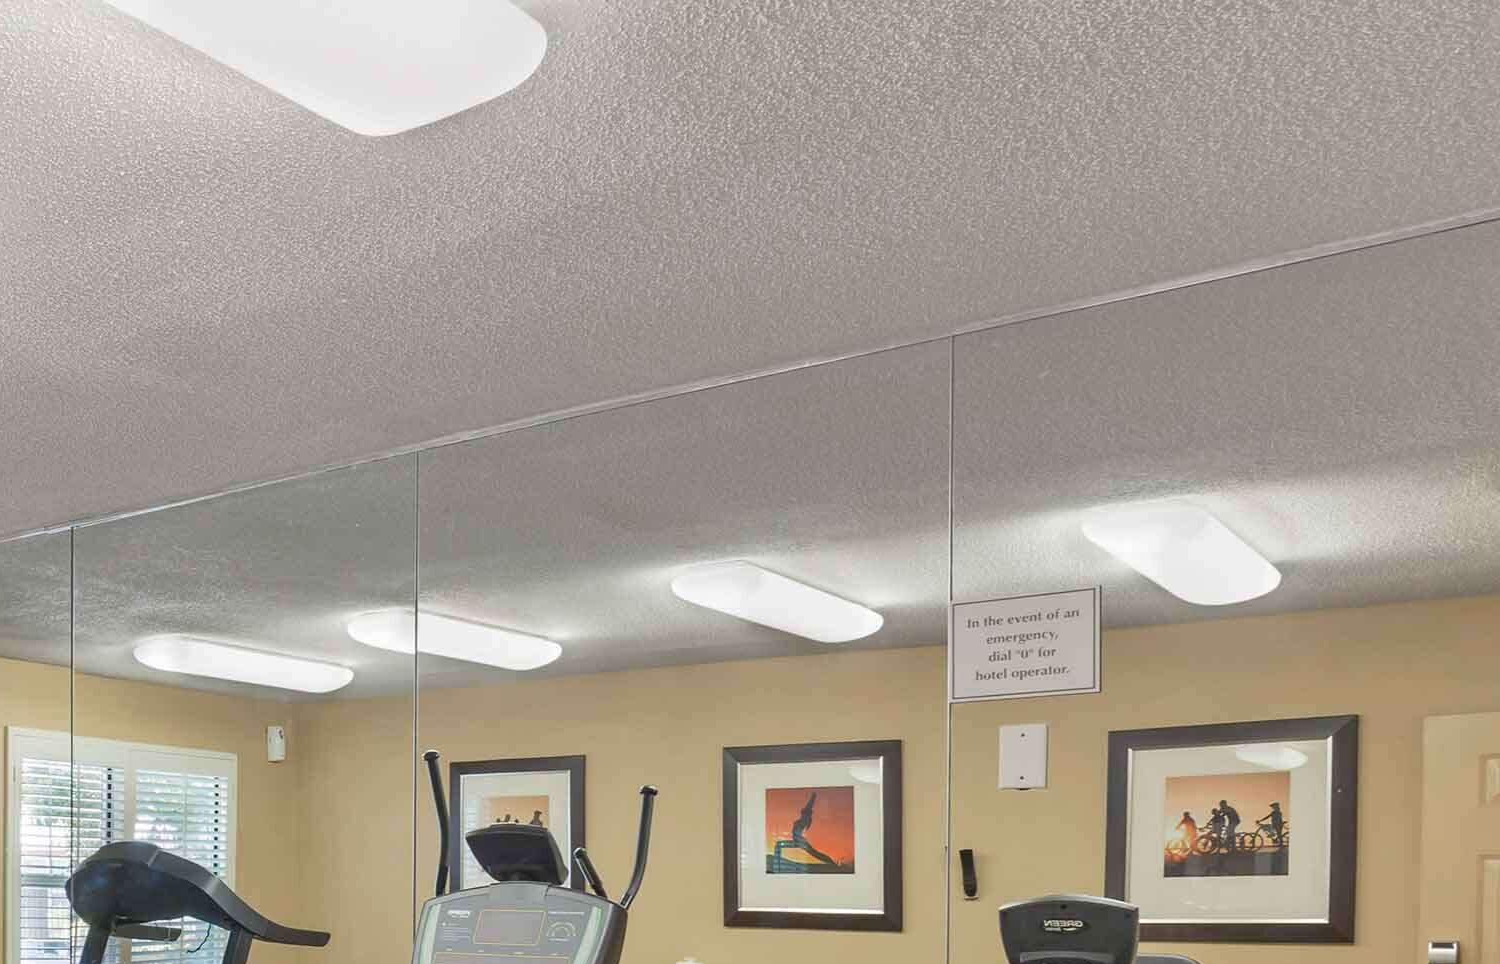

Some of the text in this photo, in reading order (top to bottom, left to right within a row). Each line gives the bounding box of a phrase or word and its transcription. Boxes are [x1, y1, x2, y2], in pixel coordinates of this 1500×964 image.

[967, 608, 1080, 629] In the event of an
[986, 631, 1059, 644] emergency,
[988, 650, 1012, 662] dial
[1038, 646, 1057, 657] for
[975, 665, 1070, 681] hotel operator.
